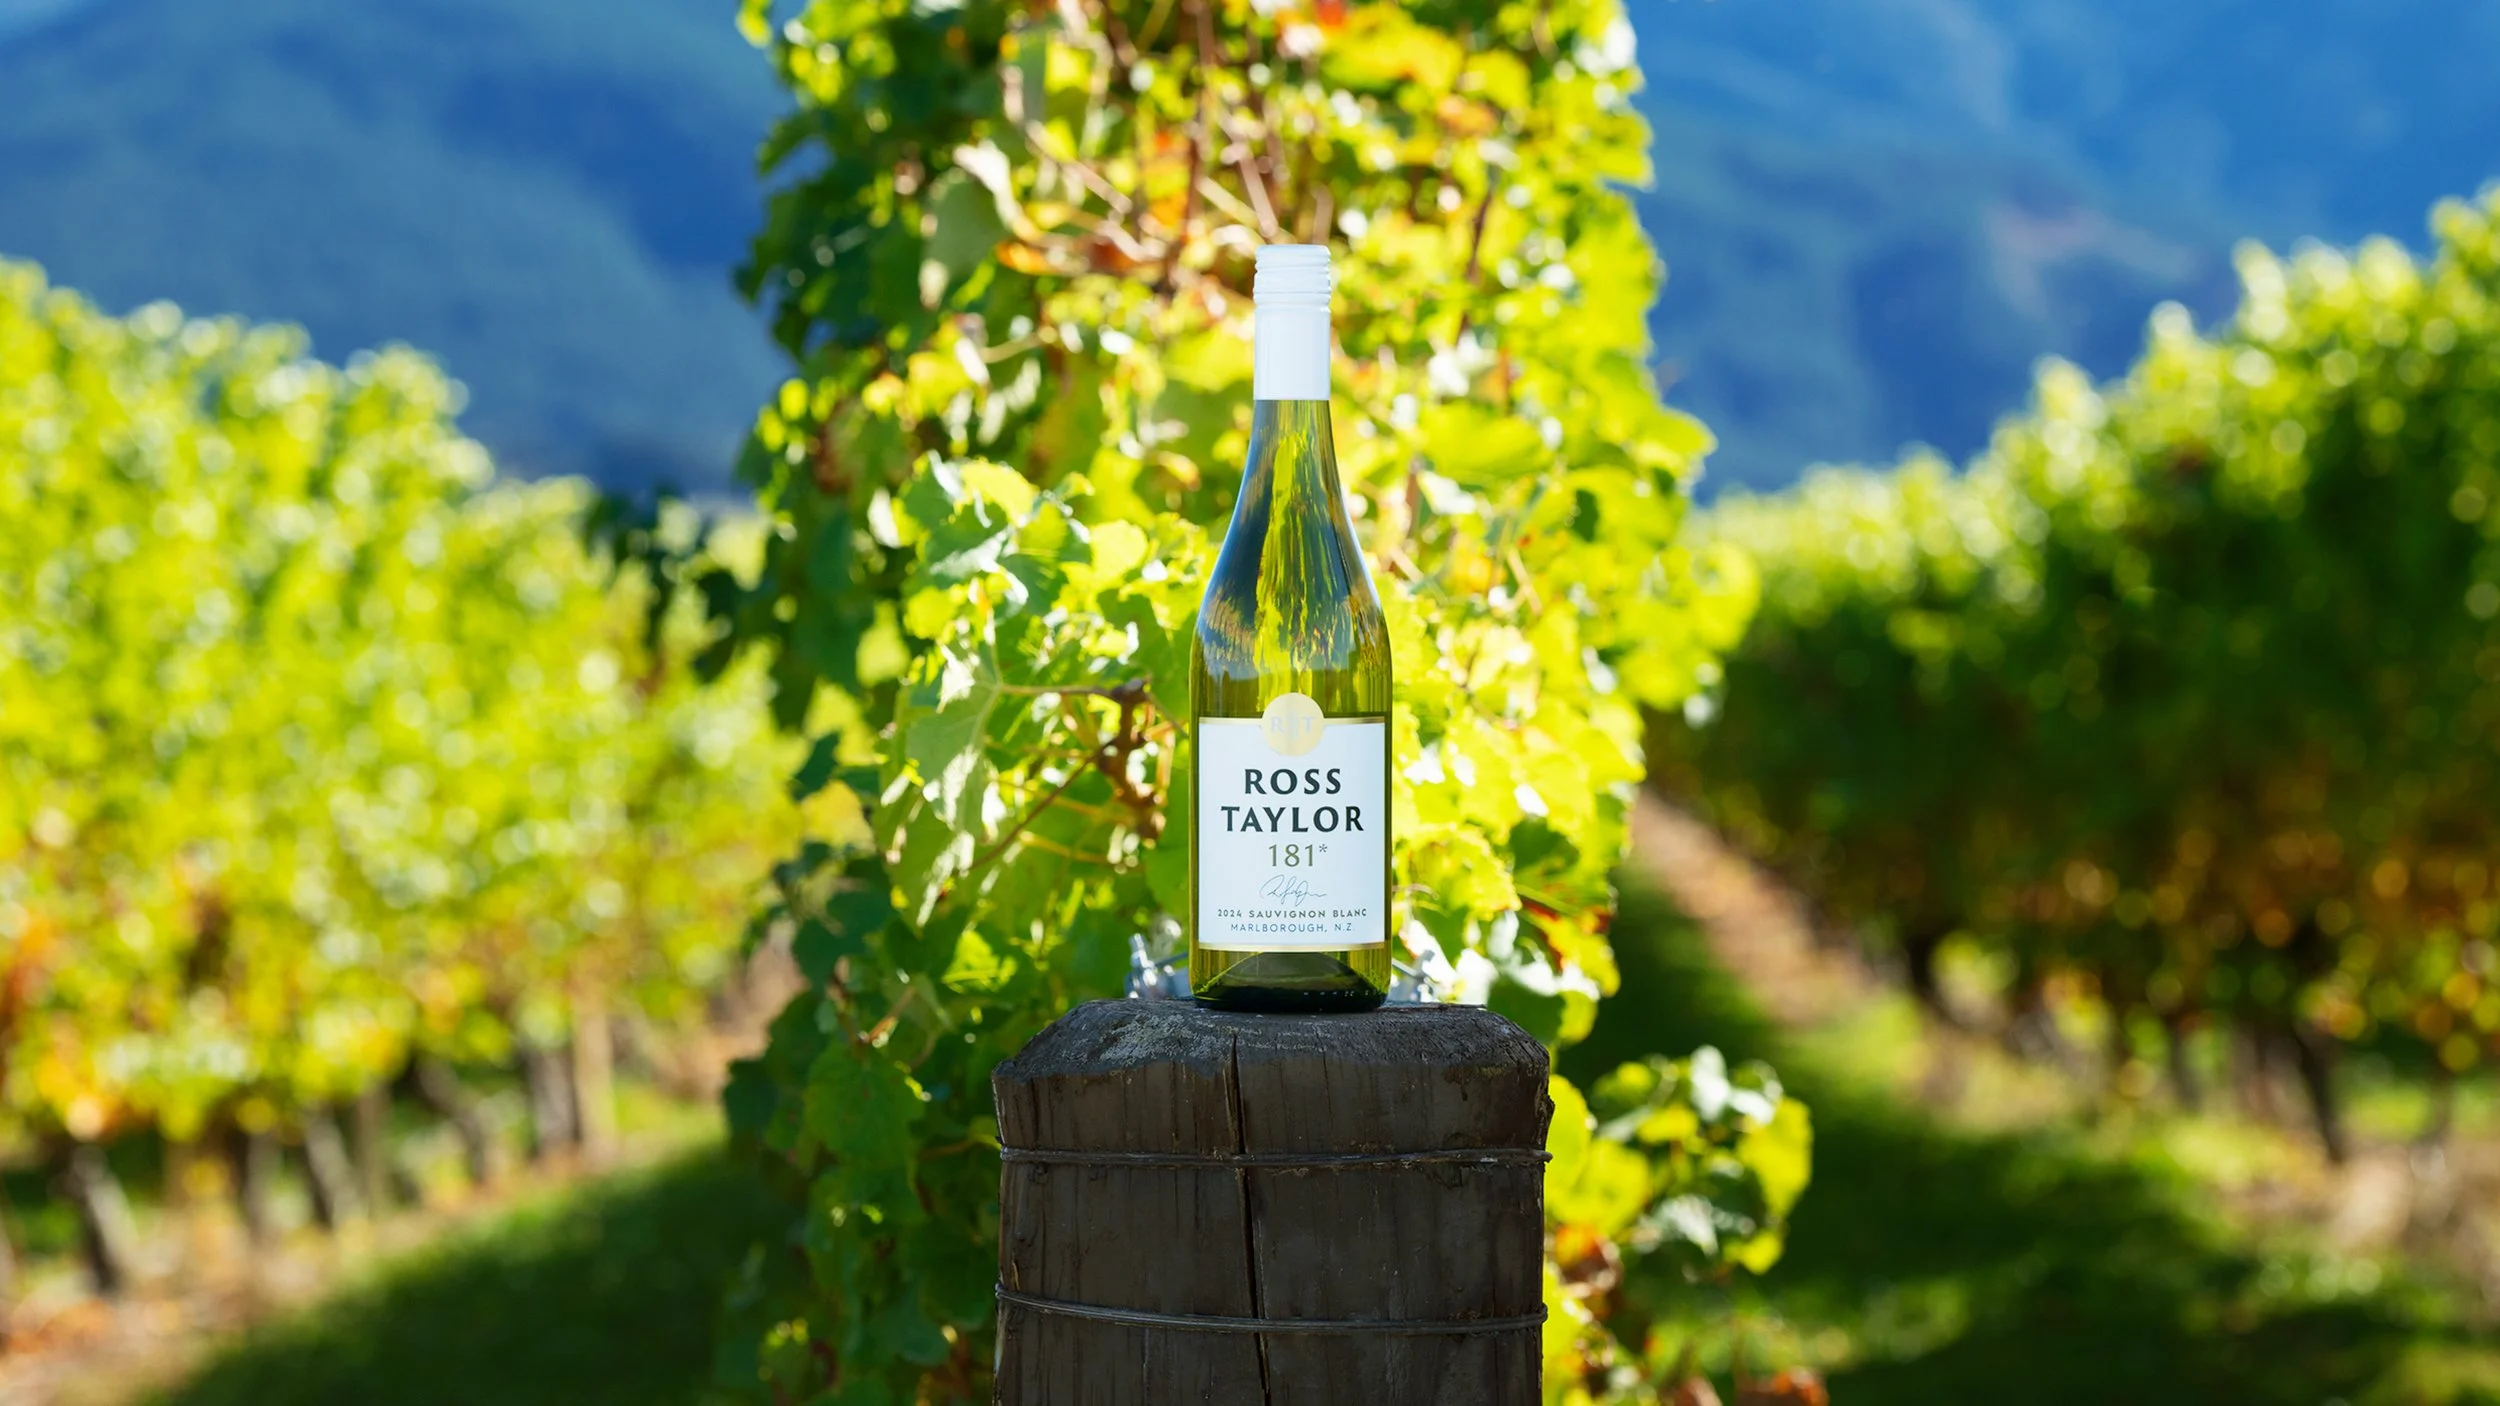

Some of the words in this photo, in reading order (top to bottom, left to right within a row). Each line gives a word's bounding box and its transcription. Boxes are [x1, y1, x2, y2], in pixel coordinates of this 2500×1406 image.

[1244, 768, 1342, 795] ROSS
[1221, 806, 1364, 832] TAYLOR
[1217, 909, 1242, 918] 2024
[1248, 909, 1326, 919] SAUVIGNON
[1332, 908, 1367, 918] BLANC
[1230, 923, 1328, 933] MARLBOROUGH,
